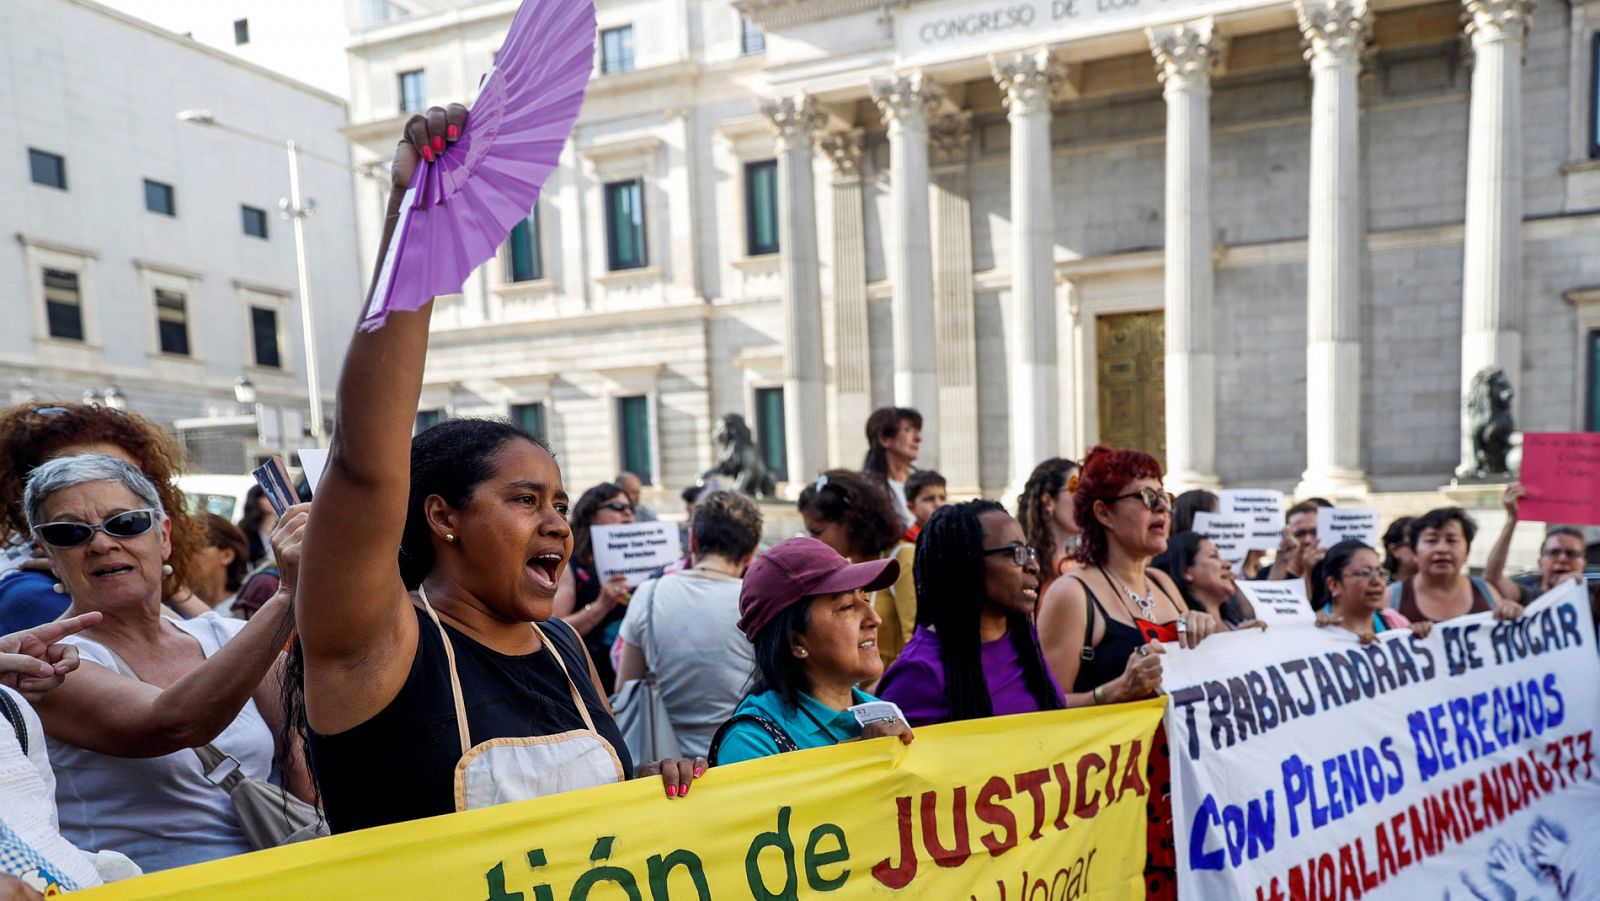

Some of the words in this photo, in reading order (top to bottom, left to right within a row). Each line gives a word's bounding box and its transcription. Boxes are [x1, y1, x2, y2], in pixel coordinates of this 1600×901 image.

[918, 7, 1036, 44] CONGRESO
[1052, 0, 1079, 19] DE
[1171, 633, 1435, 760] TRABAJADORAS
[1442, 624, 1483, 677] DE
[745, 806, 850, 901] de
[871, 740, 1149, 889] JUSTICIA
[1189, 789, 1275, 871] CON
[1281, 736, 1404, 838] PLENOS
[1407, 673, 1565, 782] DERECHOS
